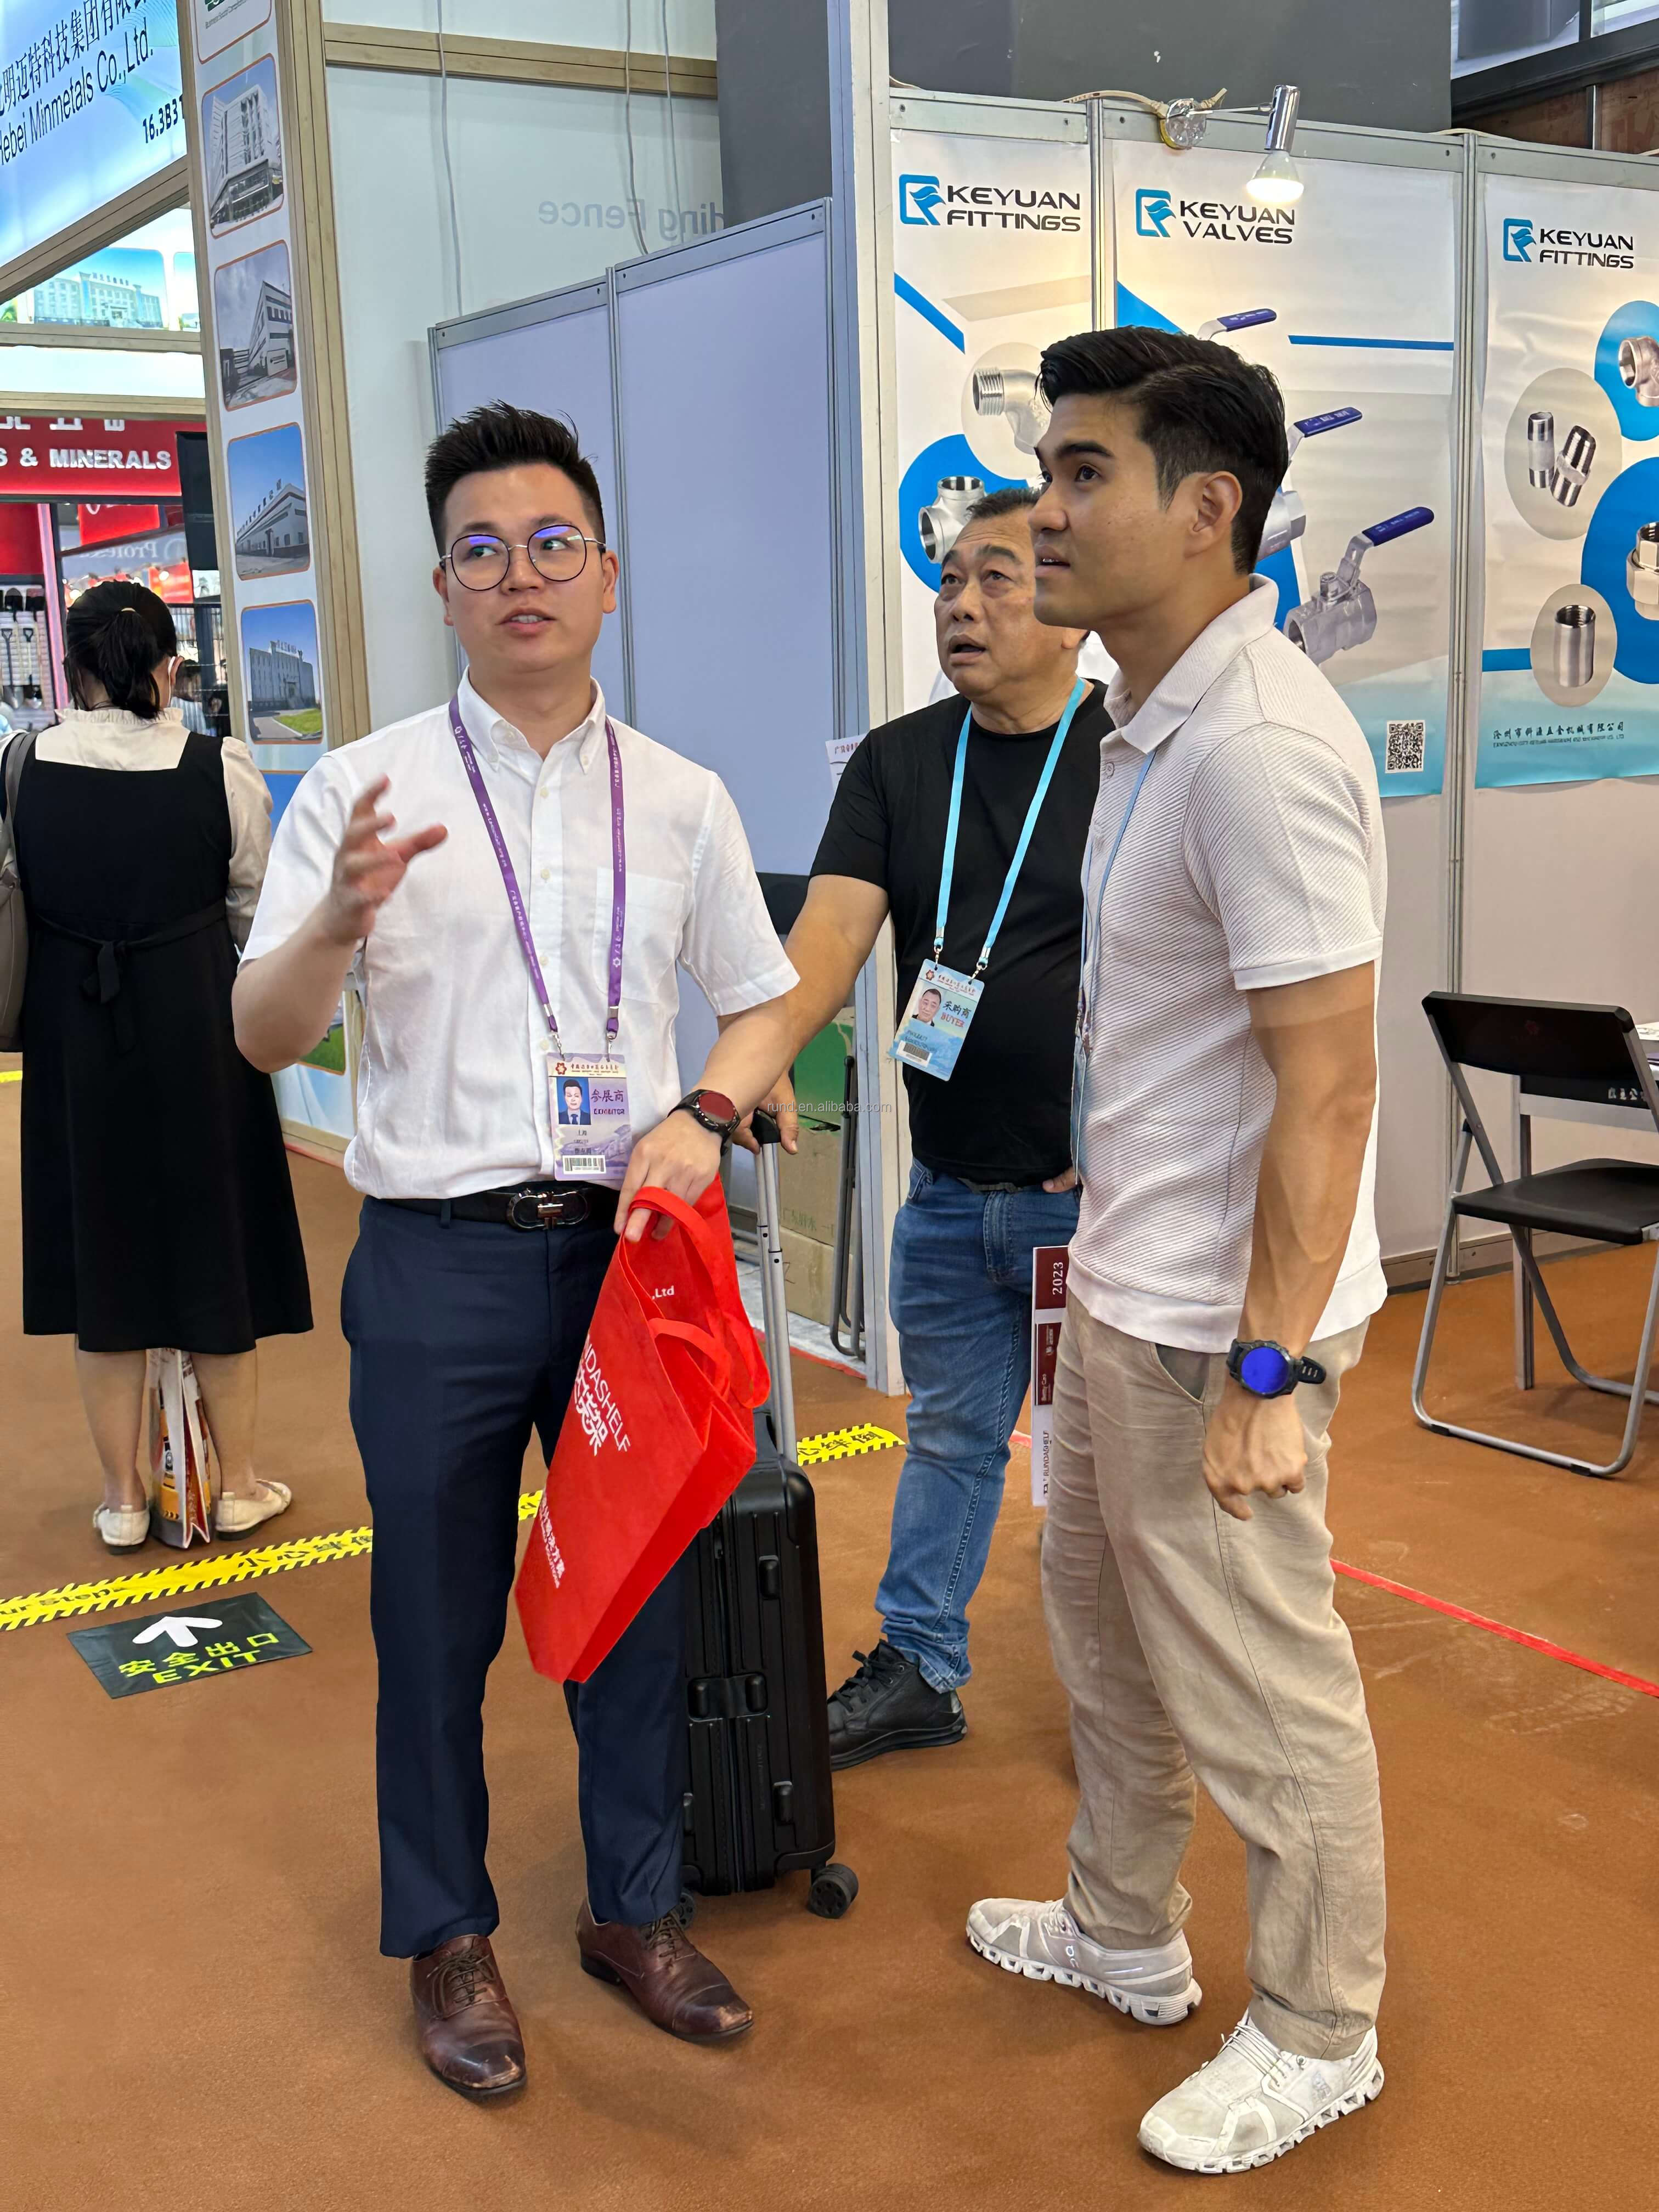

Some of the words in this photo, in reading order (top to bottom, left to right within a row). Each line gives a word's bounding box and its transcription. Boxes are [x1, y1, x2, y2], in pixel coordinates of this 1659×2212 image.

[29, 66, 93, 144] Minmetals
[97, 17, 153, 92] Co.,Ltd.
[947, 185, 1080, 211] KEYUAN
[947, 209, 1081, 232] FITTINGS
[1180, 200, 1295, 225] KEYUAN
[1183, 221, 1294, 245] VALVES
[1540, 229, 1634, 250] KEYUAN
[1539, 250, 1634, 269] FITTINGS
[20, 447, 38, 467] &
[49, 449, 172, 470] MINERALS
[1052, 1262, 1064, 1296] 2023
[119, 1632, 279, 1677] 安全出口
[153, 1649, 261, 1684] EXIT
